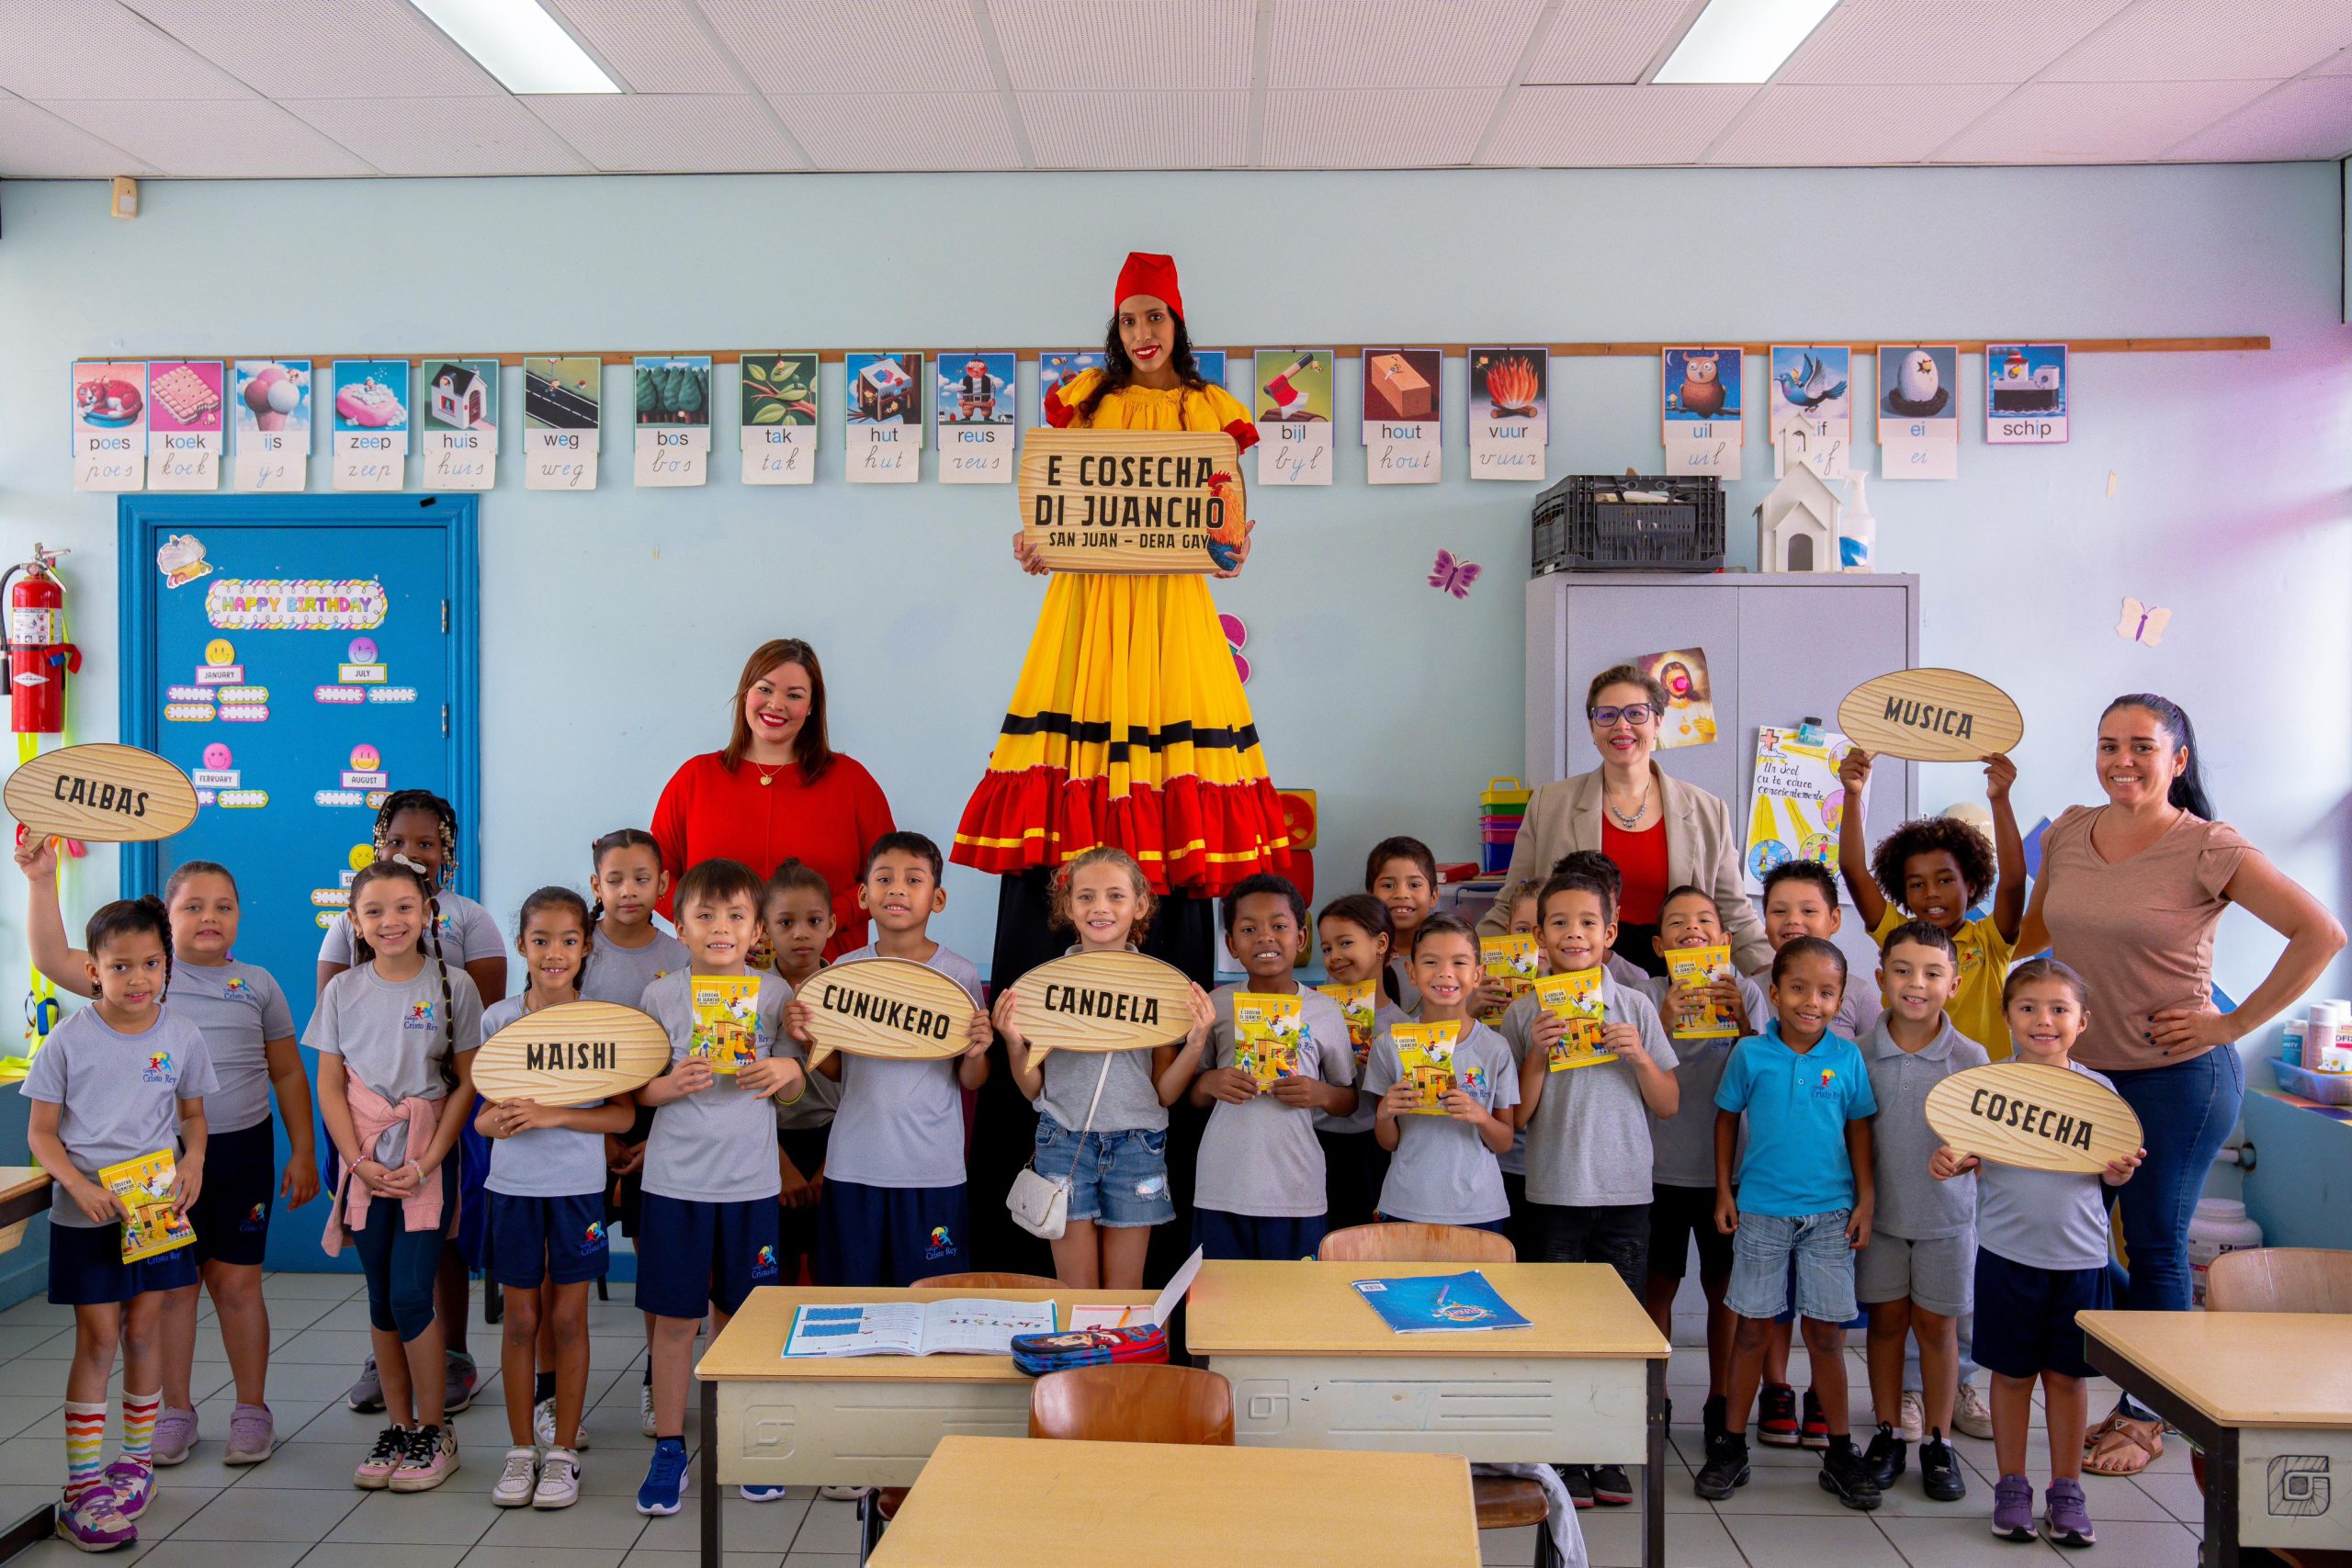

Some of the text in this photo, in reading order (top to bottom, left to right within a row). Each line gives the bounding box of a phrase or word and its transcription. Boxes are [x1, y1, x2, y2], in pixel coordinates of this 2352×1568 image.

[765, 429, 792, 443] tak
[871, 427, 899, 442] hut
[957, 429, 995, 442] reus
[1282, 424, 1306, 443] bijl
[1383, 423, 1421, 439] hout
[1489, 427, 1528, 439] vuur
[1692, 422, 1713, 438] uil
[1911, 422, 1926, 436] ei
[2003, 421, 2052, 439] schip
[90, 437, 130, 451] poes
[165, 434, 206, 448] koek
[265, 434, 282, 450] ijs
[351, 436, 391, 450] zeep
[443, 434, 478, 448] huis
[544, 434, 579, 449] weg
[658, 431, 688, 446] bos
[652, 450, 691, 472] bos
[762, 447, 798, 470] tak
[865, 445, 902, 468] hut
[1380, 445, 1430, 468] hout
[1479, 451, 1536, 465] vuur
[1689, 443, 1724, 466] uil
[1813, 440, 1840, 476] if
[1911, 449, 1928, 464] ei
[162, 452, 209, 476] koek
[438, 453, 484, 475] huis
[952, 457, 1000, 469] reus
[85, 463, 132, 483] poes
[348, 464, 390, 482] zeep
[542, 463, 583, 487] weg
[1047, 456, 1214, 488] E COSECHA
[1035, 494, 1225, 529] DI JUANCHO
[1049, 532, 1075, 547] SAN
[1081, 533, 1117, 547] JUAN
[1140, 534, 1175, 548] DERA
[1182, 535, 1210, 549] GAY
[222, 596, 372, 613] HAPPY BIRTHDAY
[204, 671, 235, 680] JANUARY
[355, 670, 371, 678] JULY
[1883, 696, 1973, 740] MUSICA
[1764, 762, 1776, 773] Un
[199, 775, 232, 784] FEBRUARY
[352, 776, 378, 784] AUGUST
[1786, 777, 1813, 788] educa
[54, 775, 150, 817] CALBAS
[823, 985, 950, 1040] CUNUKERO
[1045, 985, 1159, 1025] CANDELA
[404, 1021, 438, 1032] Cristo Rey
[758, 1034, 770, 1044] Rey
[1305, 1042, 1316, 1052] Rey
[526, 1043, 616, 1070] MAISHI
[143, 1074, 177, 1085] Cristo Rey
[1970, 1089, 2093, 1152] COSECHA
[925, 1247, 956, 1260] Cristo Rey
